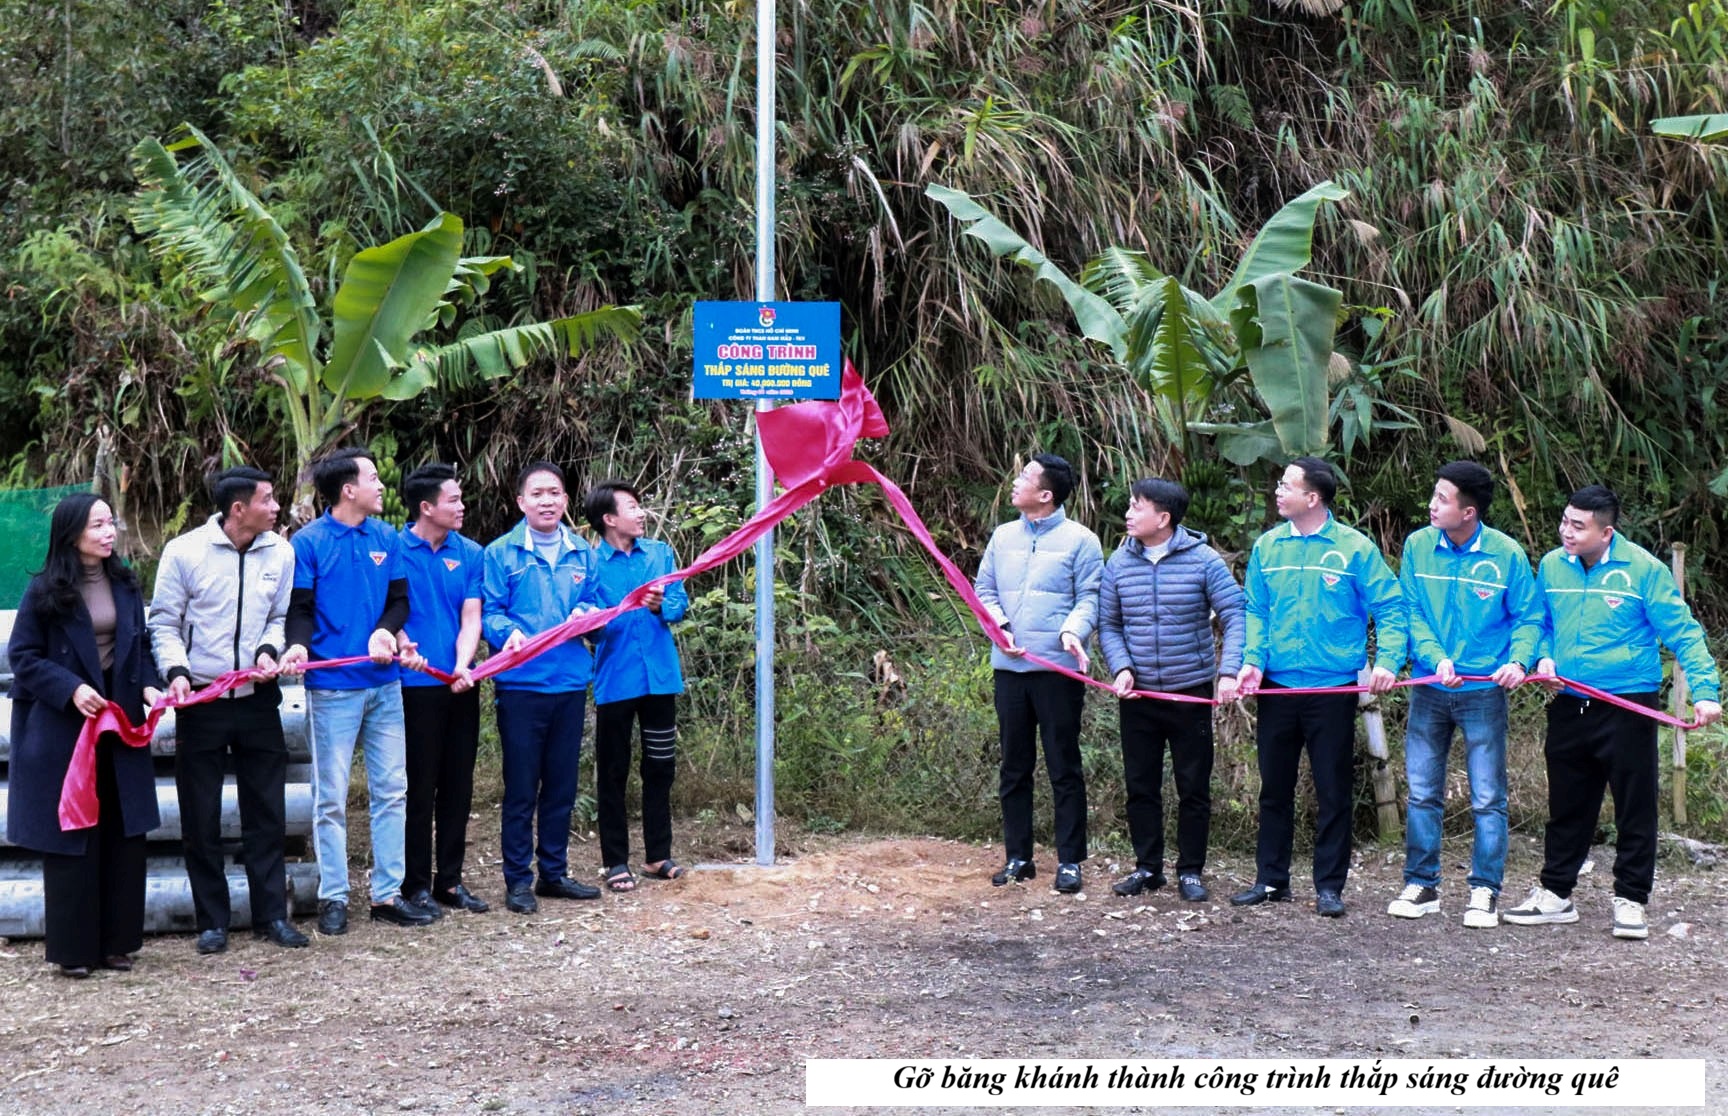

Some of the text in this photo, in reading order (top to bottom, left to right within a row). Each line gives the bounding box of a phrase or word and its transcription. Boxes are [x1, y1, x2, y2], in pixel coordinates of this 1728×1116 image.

[718, 343, 817, 359] CÔNG TRÌNH
[704, 361, 830, 377] THẮP SÁNG ĐƯỜNG QUÊ
[722, 379, 734, 388] TRỊ
[735, 378, 750, 387] GIÁ:
[792, 378, 813, 387] ĐỒNG
